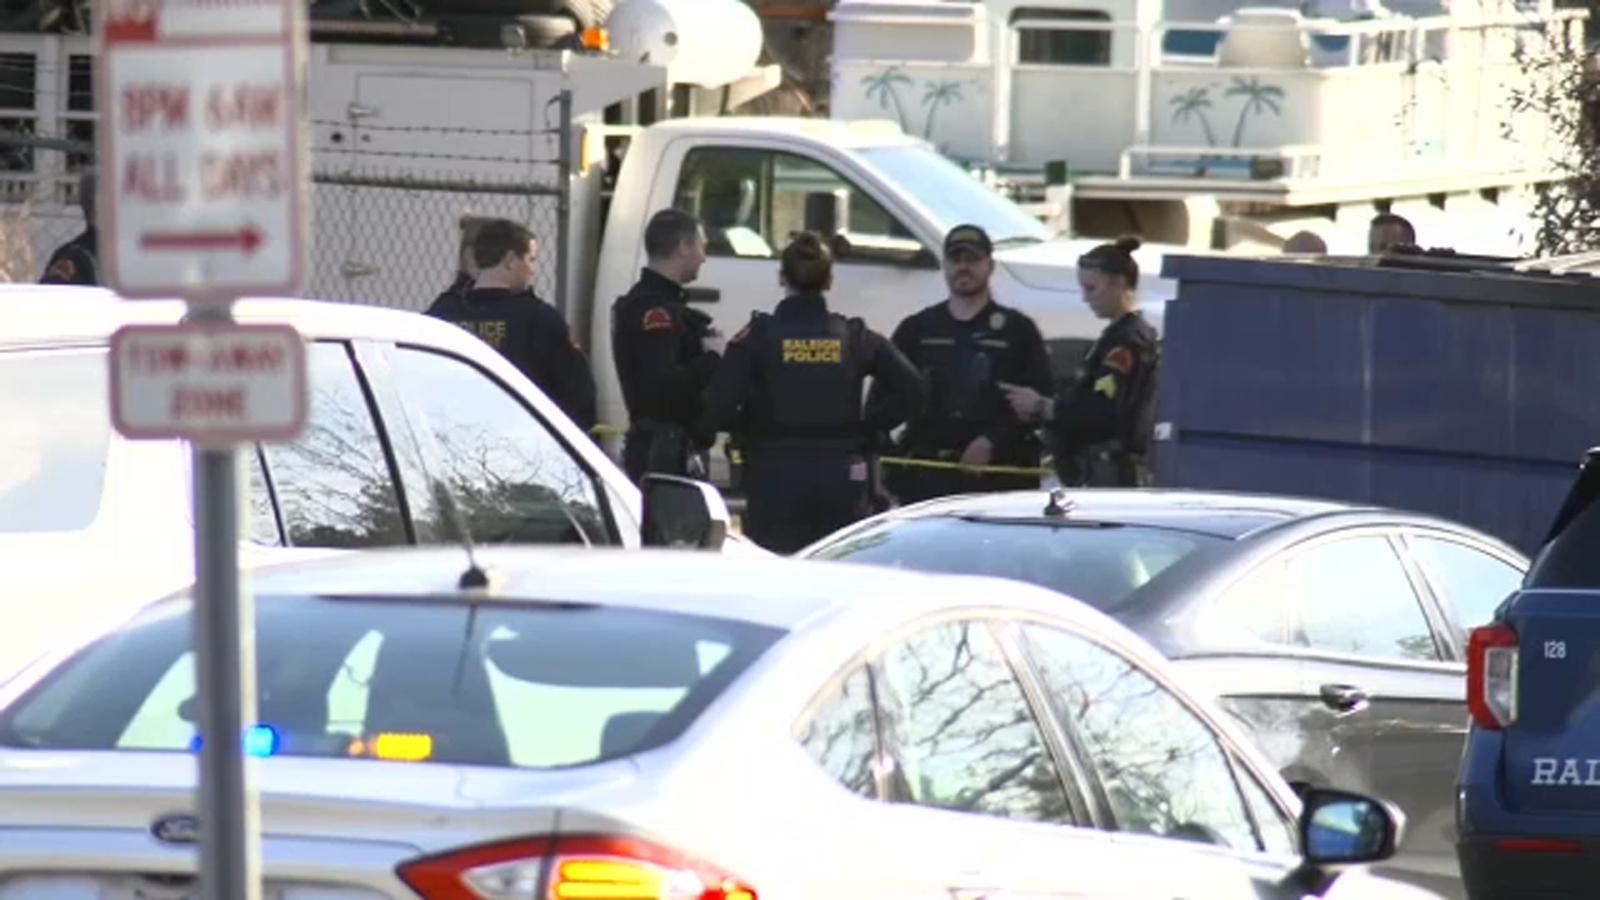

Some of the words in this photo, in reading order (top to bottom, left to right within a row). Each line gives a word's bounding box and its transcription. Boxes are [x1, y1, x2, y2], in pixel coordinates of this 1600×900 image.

[122, 153, 187, 200] ALL
[201, 152, 282, 200] DAYS
[457, 320, 506, 338] OLICE
[782, 339, 841, 350] RALEIGH
[782, 350, 841, 363] POLICE
[172, 387, 244, 418] ZONE
[1544, 641, 1566, 659] 128
[1530, 757, 1600, 786] RAL
